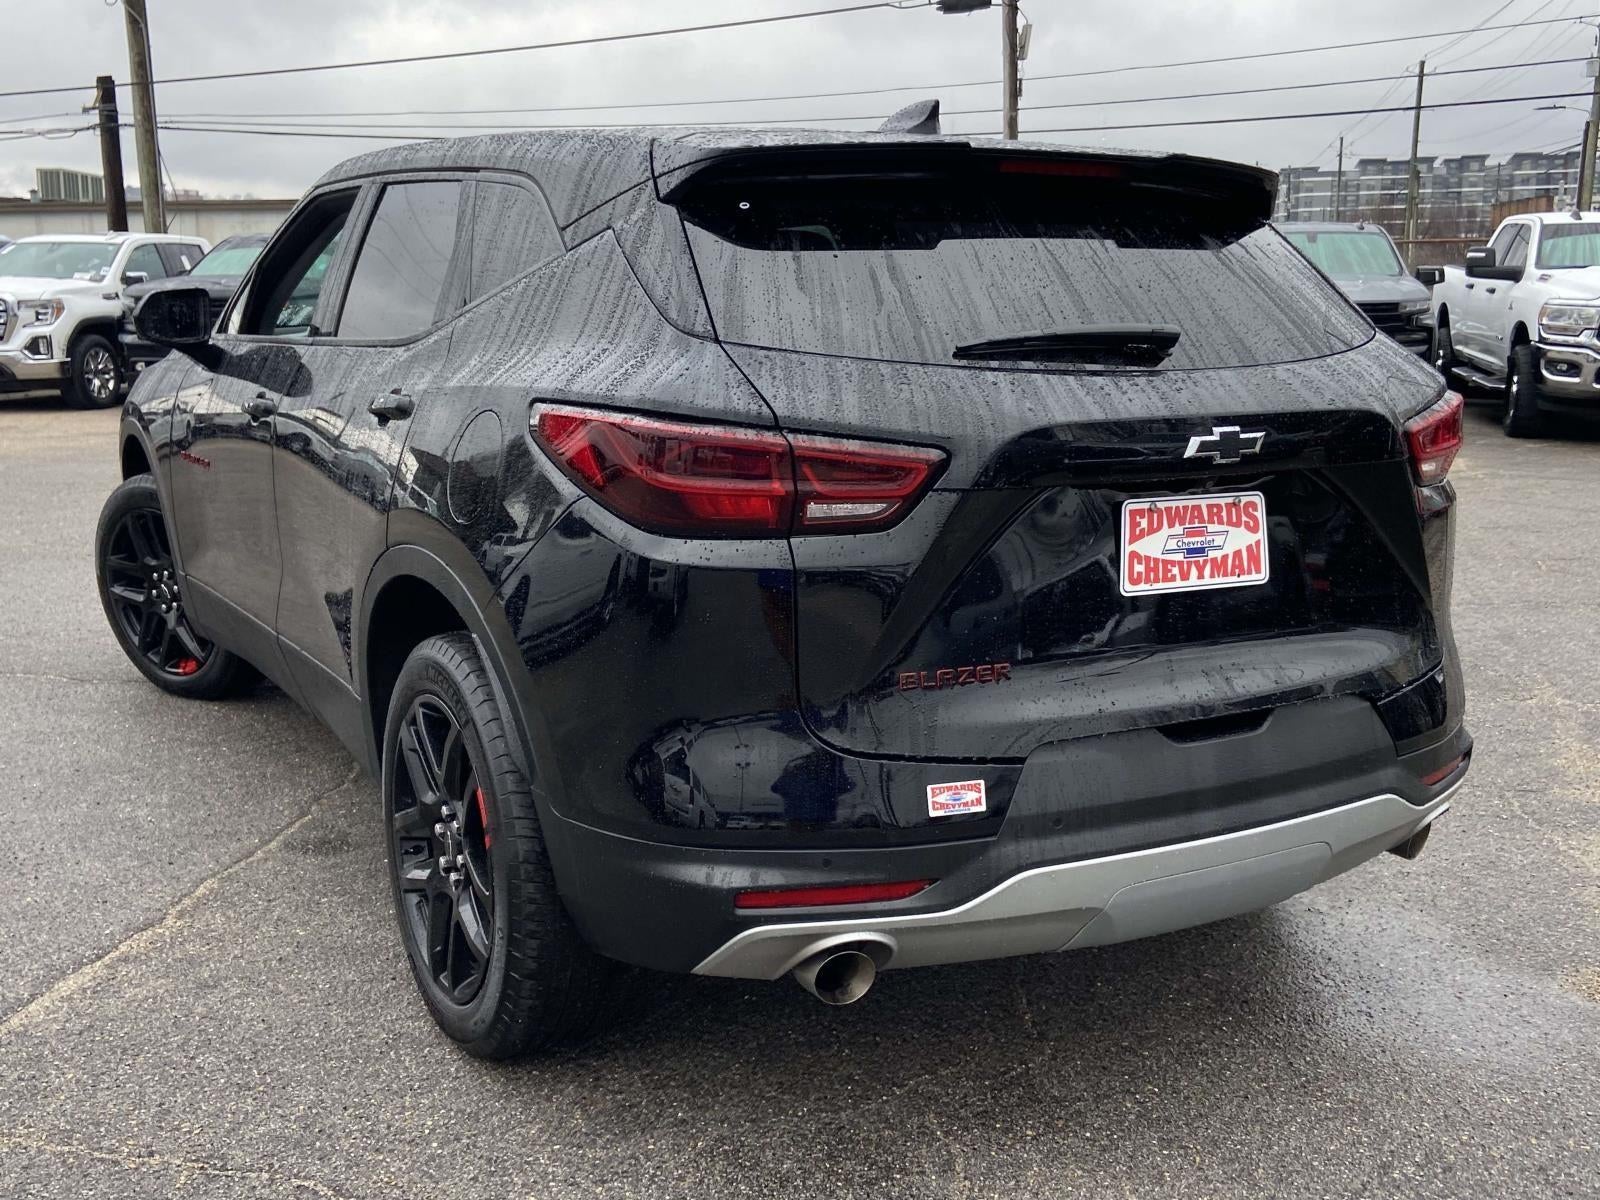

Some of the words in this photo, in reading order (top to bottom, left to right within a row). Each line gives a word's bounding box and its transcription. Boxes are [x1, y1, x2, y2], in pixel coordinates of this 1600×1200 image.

[1128, 500, 1260, 546] EDWARDS
[1176, 538, 1215, 548] Chevrolet
[1127, 539, 1262, 586] CHEVYMAN
[899, 662, 1012, 691] BLAZER
[931, 783, 982, 799] EDWARDS
[931, 796, 982, 811] CHEVYMAN
